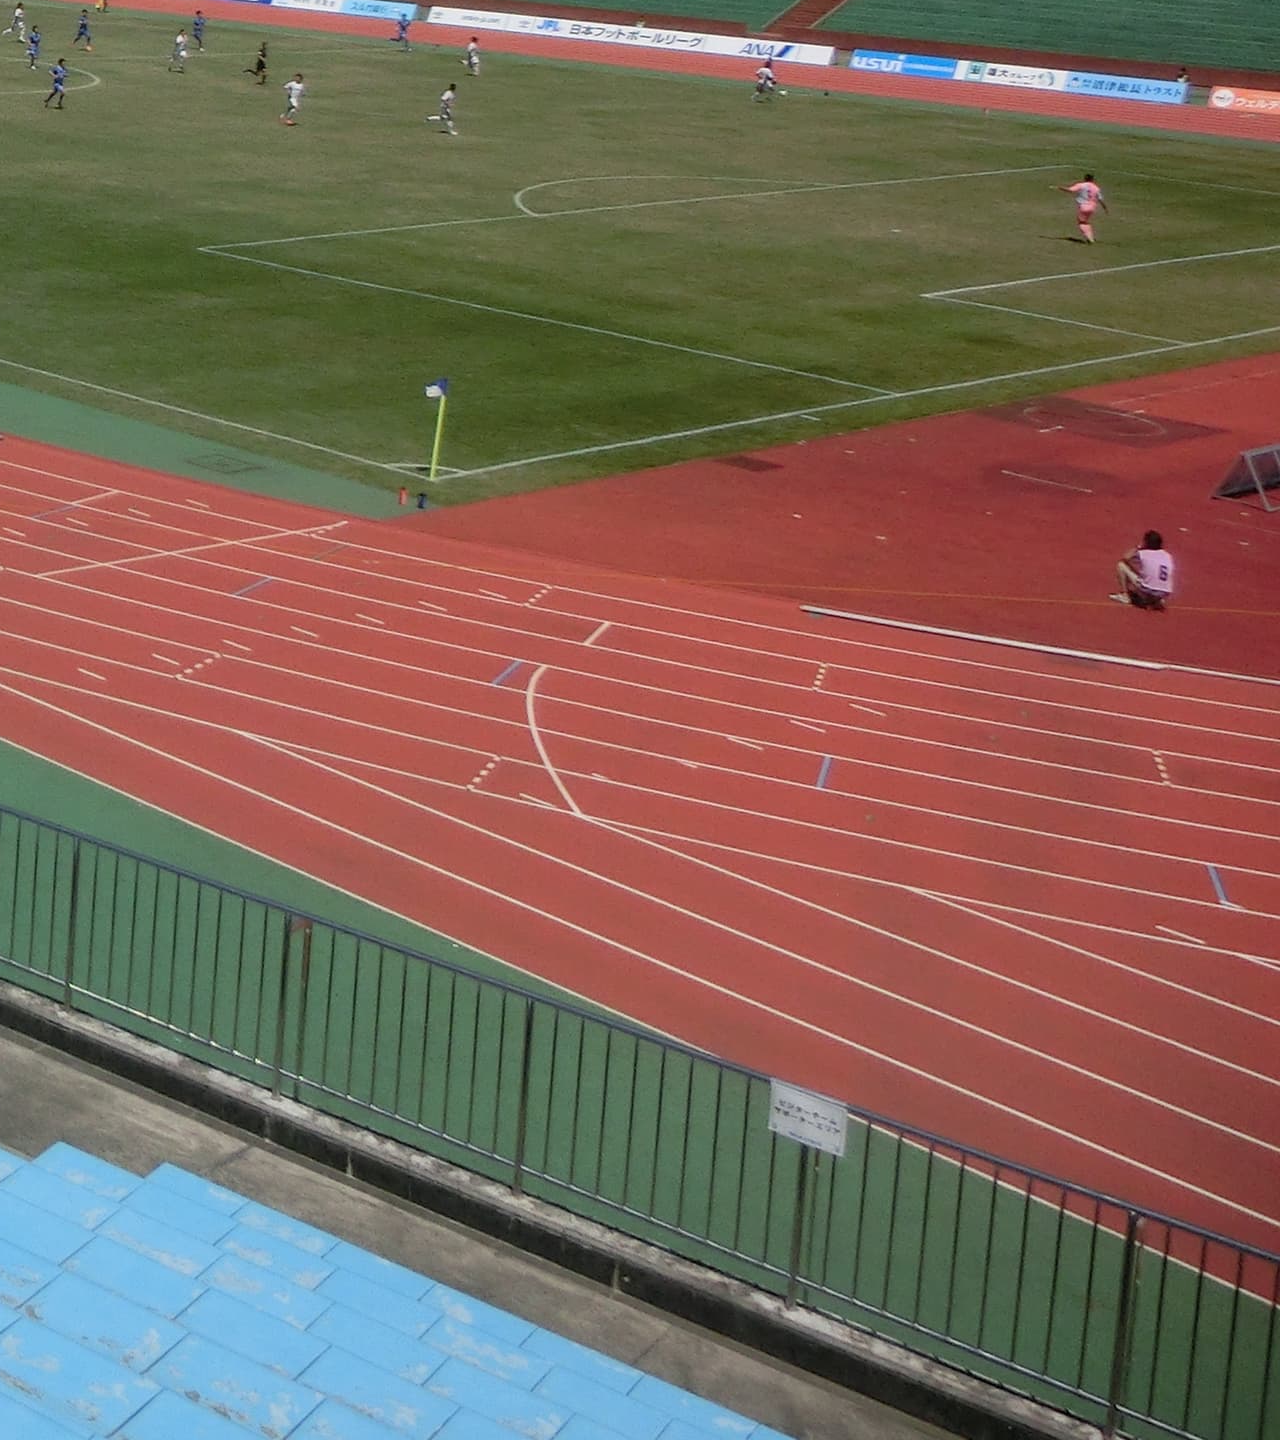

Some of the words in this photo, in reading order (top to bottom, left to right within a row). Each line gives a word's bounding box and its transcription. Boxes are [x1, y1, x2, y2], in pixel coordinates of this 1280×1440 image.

[569, 23, 704, 48] 日本フットボールリーグ
[739, 42, 776, 58] ANA
